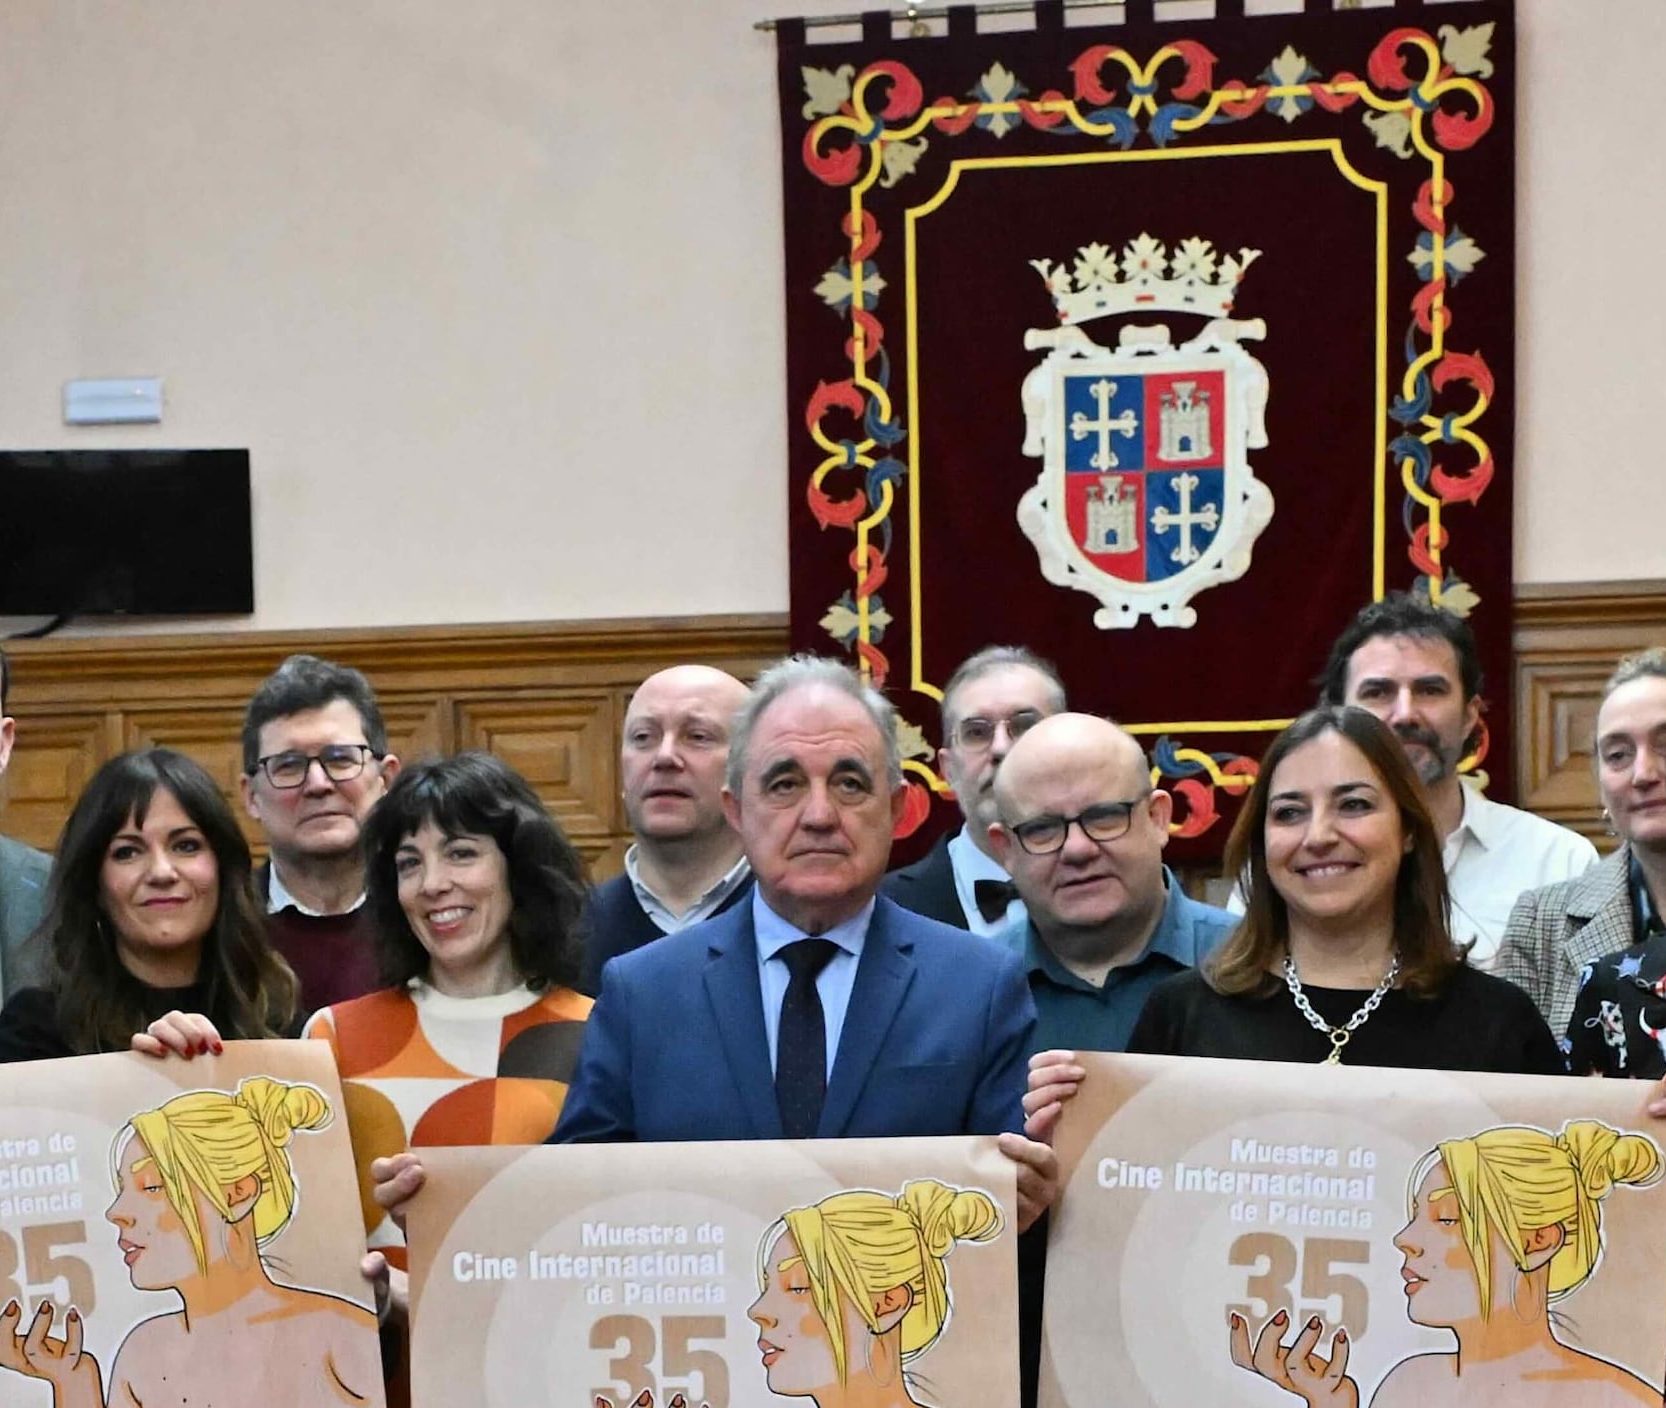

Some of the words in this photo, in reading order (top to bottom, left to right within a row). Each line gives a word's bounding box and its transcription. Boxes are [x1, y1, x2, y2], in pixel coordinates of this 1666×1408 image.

[49, 1132, 76, 1154] de
[1231, 1138, 1338, 1168] Muestra
[1348, 1147, 1377, 1168] de
[1097, 1157, 1163, 1189] Cine
[1175, 1163, 1375, 1200] Internacional
[1231, 1200, 1258, 1223] de
[1268, 1201, 1373, 1228] Palencia
[582, 1222, 687, 1247] Muestra
[697, 1222, 725, 1244] de
[453, 1251, 517, 1282] Cine
[530, 1249, 725, 1280] Internacional
[586, 1284, 613, 1305] de
[624, 1281, 725, 1305] Palencia
[1225, 1232, 1370, 1343] 35
